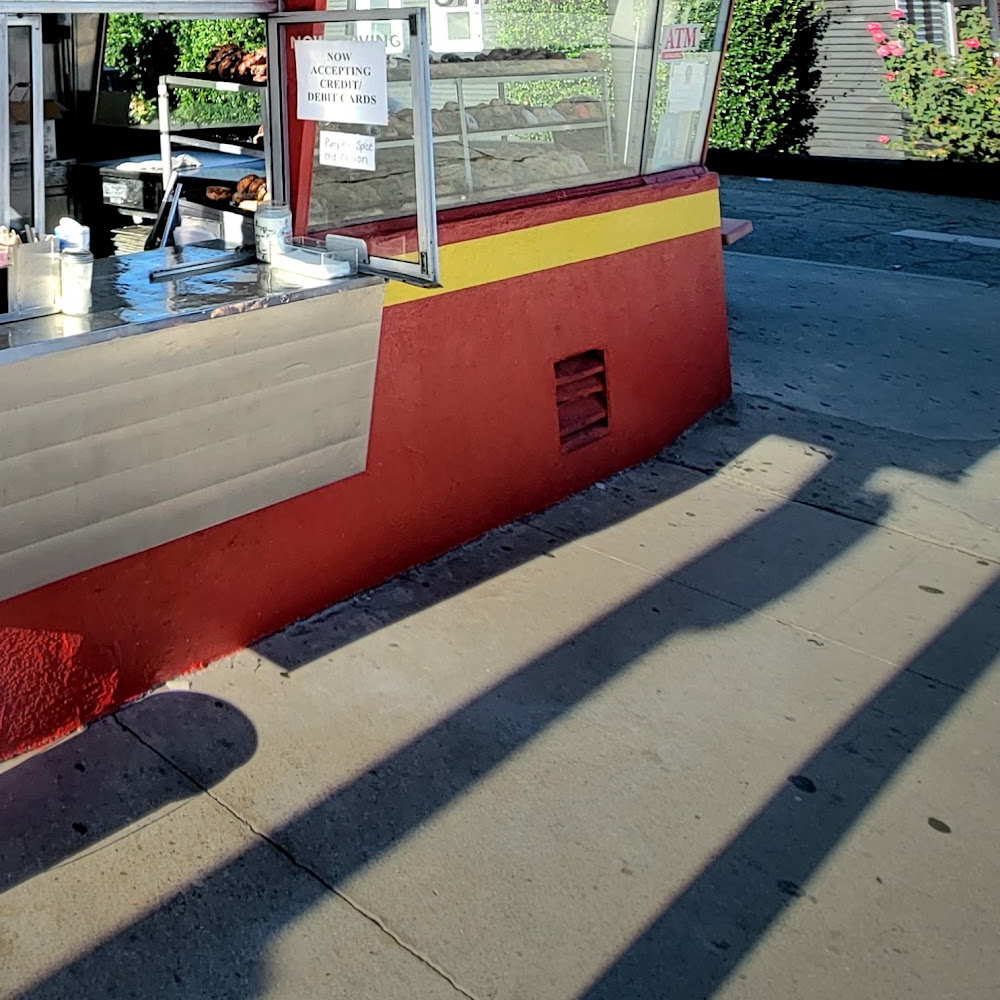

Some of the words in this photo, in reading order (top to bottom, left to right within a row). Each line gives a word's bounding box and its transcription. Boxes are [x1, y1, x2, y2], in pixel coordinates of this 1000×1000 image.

[664, 27, 697, 50] ATM
[327, 52, 352, 62] NOW
[310, 66, 371, 77] ACCEPTING
[319, 79, 363, 90] CREDIT/
[307, 92, 338, 103] DEBIT
[340, 94, 377, 105] CARDS
[356, 140, 374, 153] Spice
